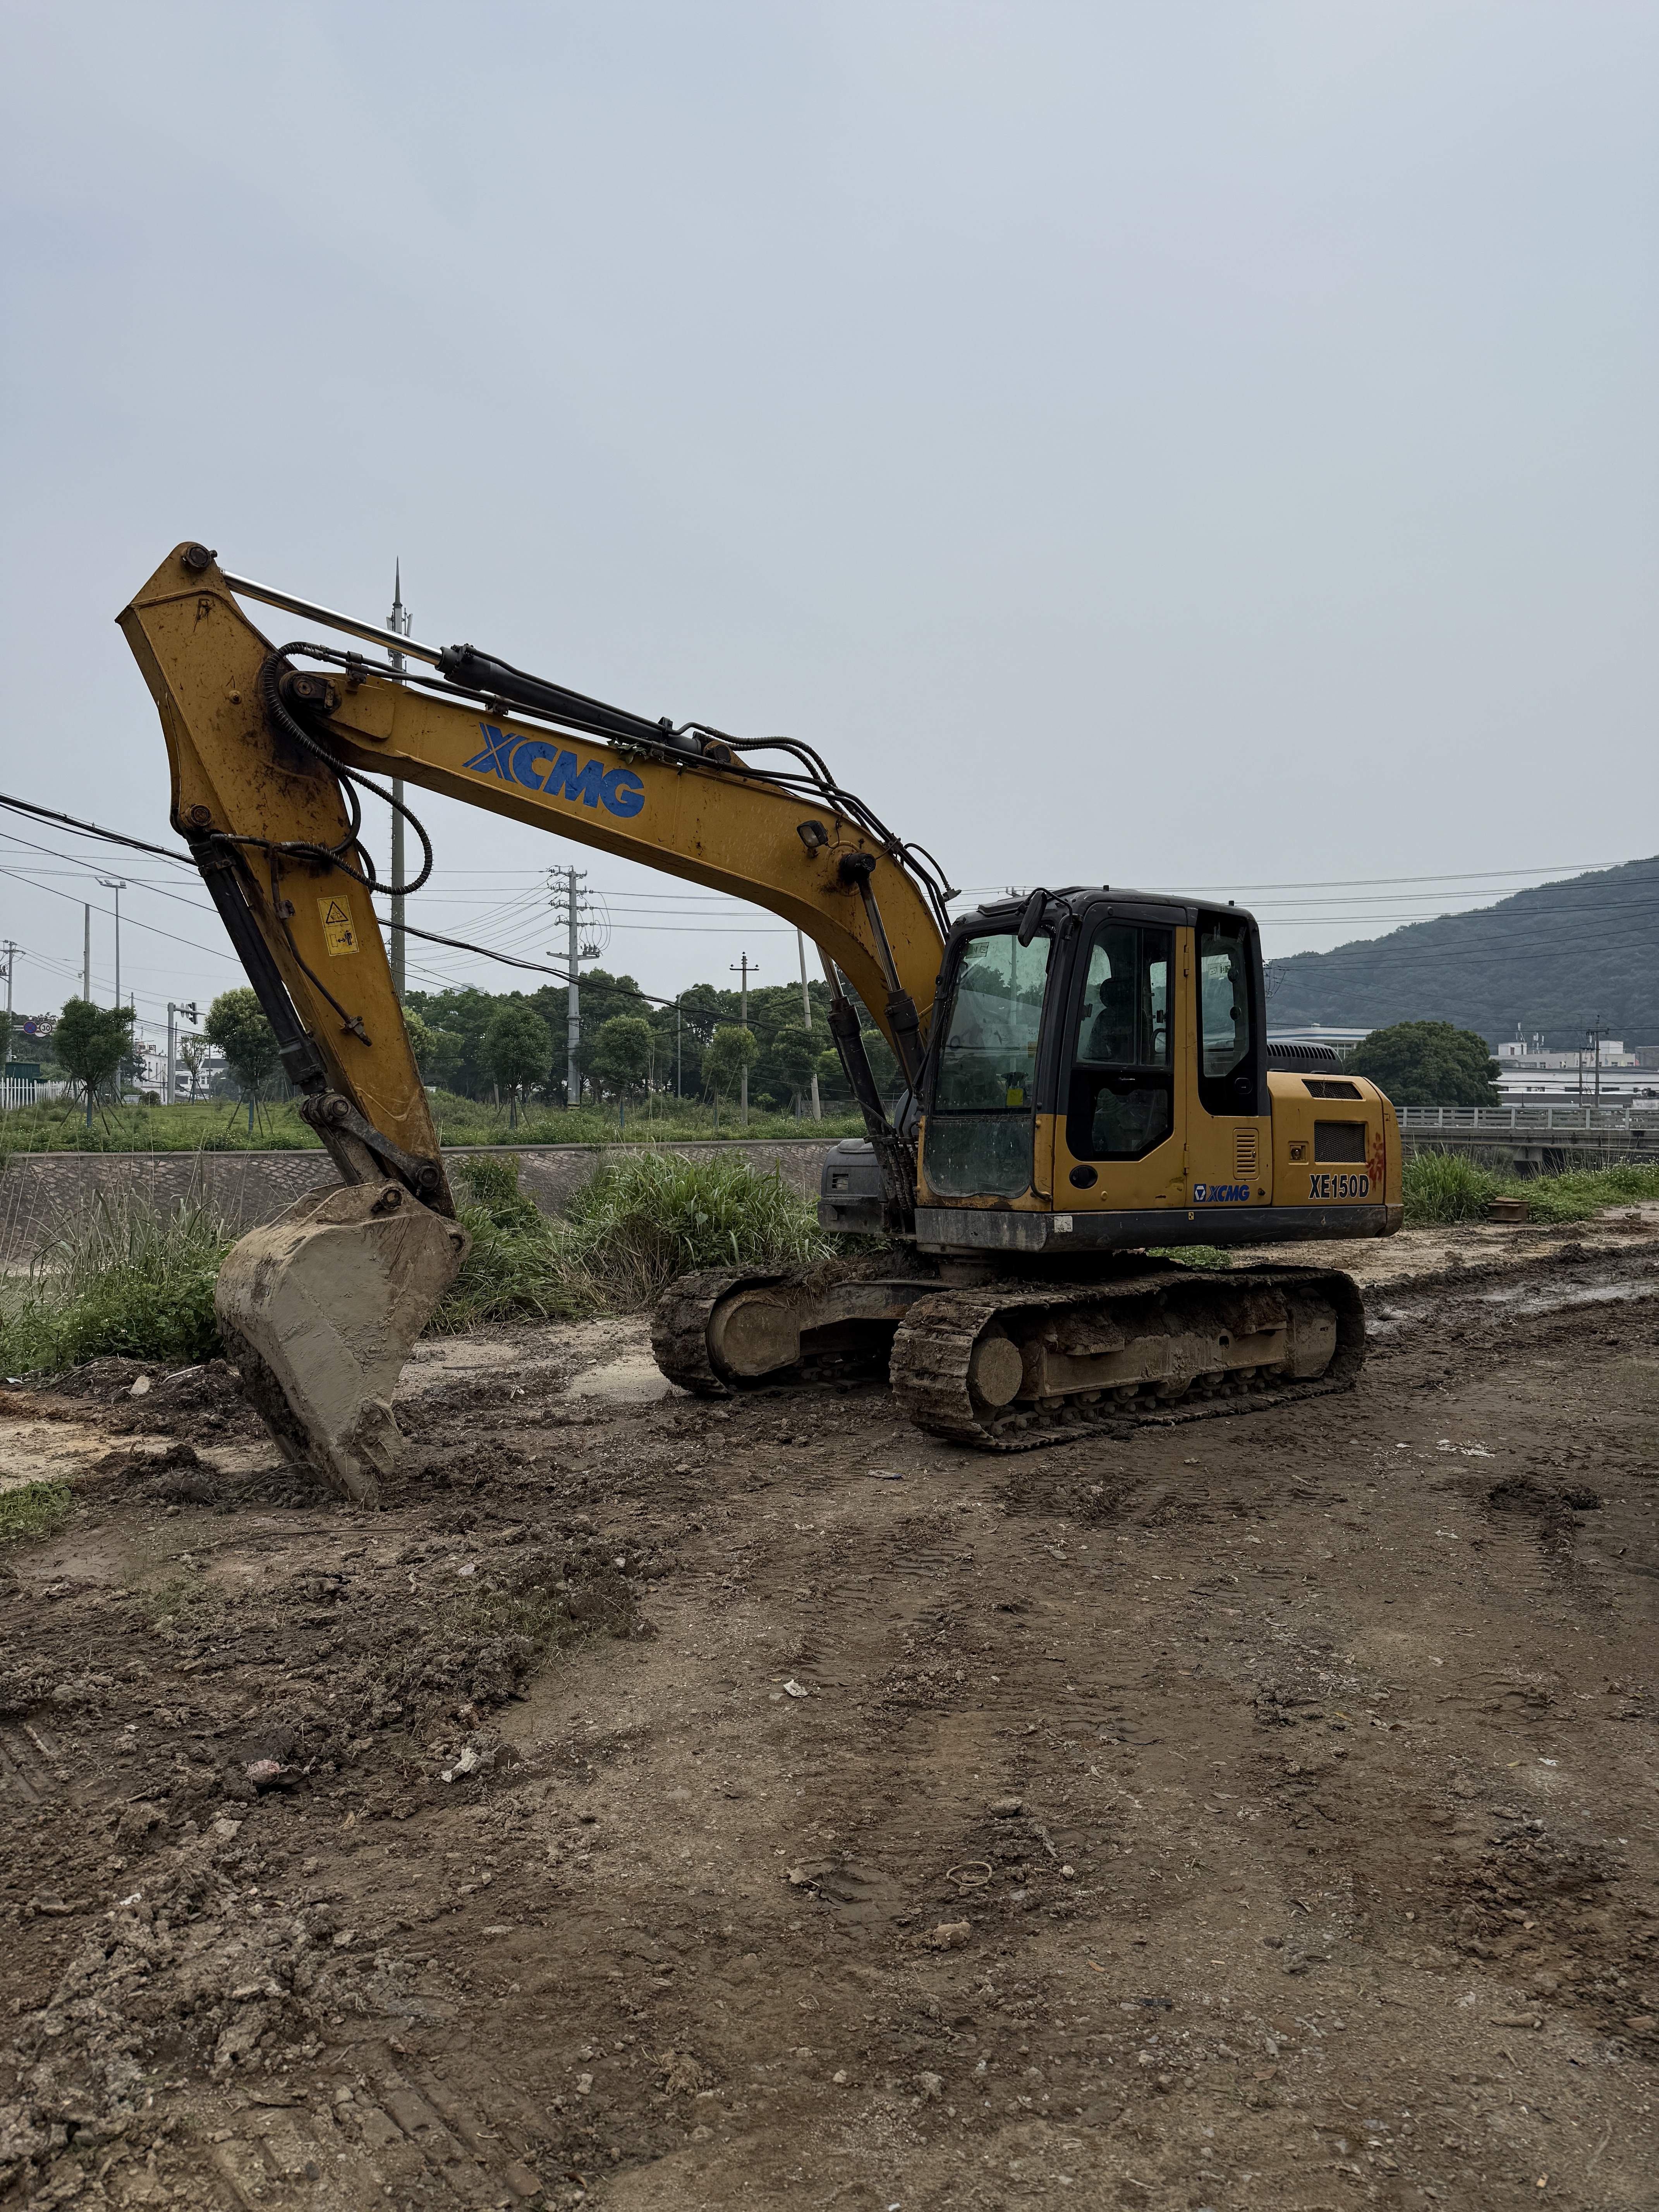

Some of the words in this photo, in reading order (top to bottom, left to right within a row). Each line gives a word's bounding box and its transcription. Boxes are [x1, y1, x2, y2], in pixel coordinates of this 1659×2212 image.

[462, 722, 645, 818] XCMG
[1206, 1185, 1250, 1202] XCMG
[1308, 1173, 1370, 1199] XE150D
